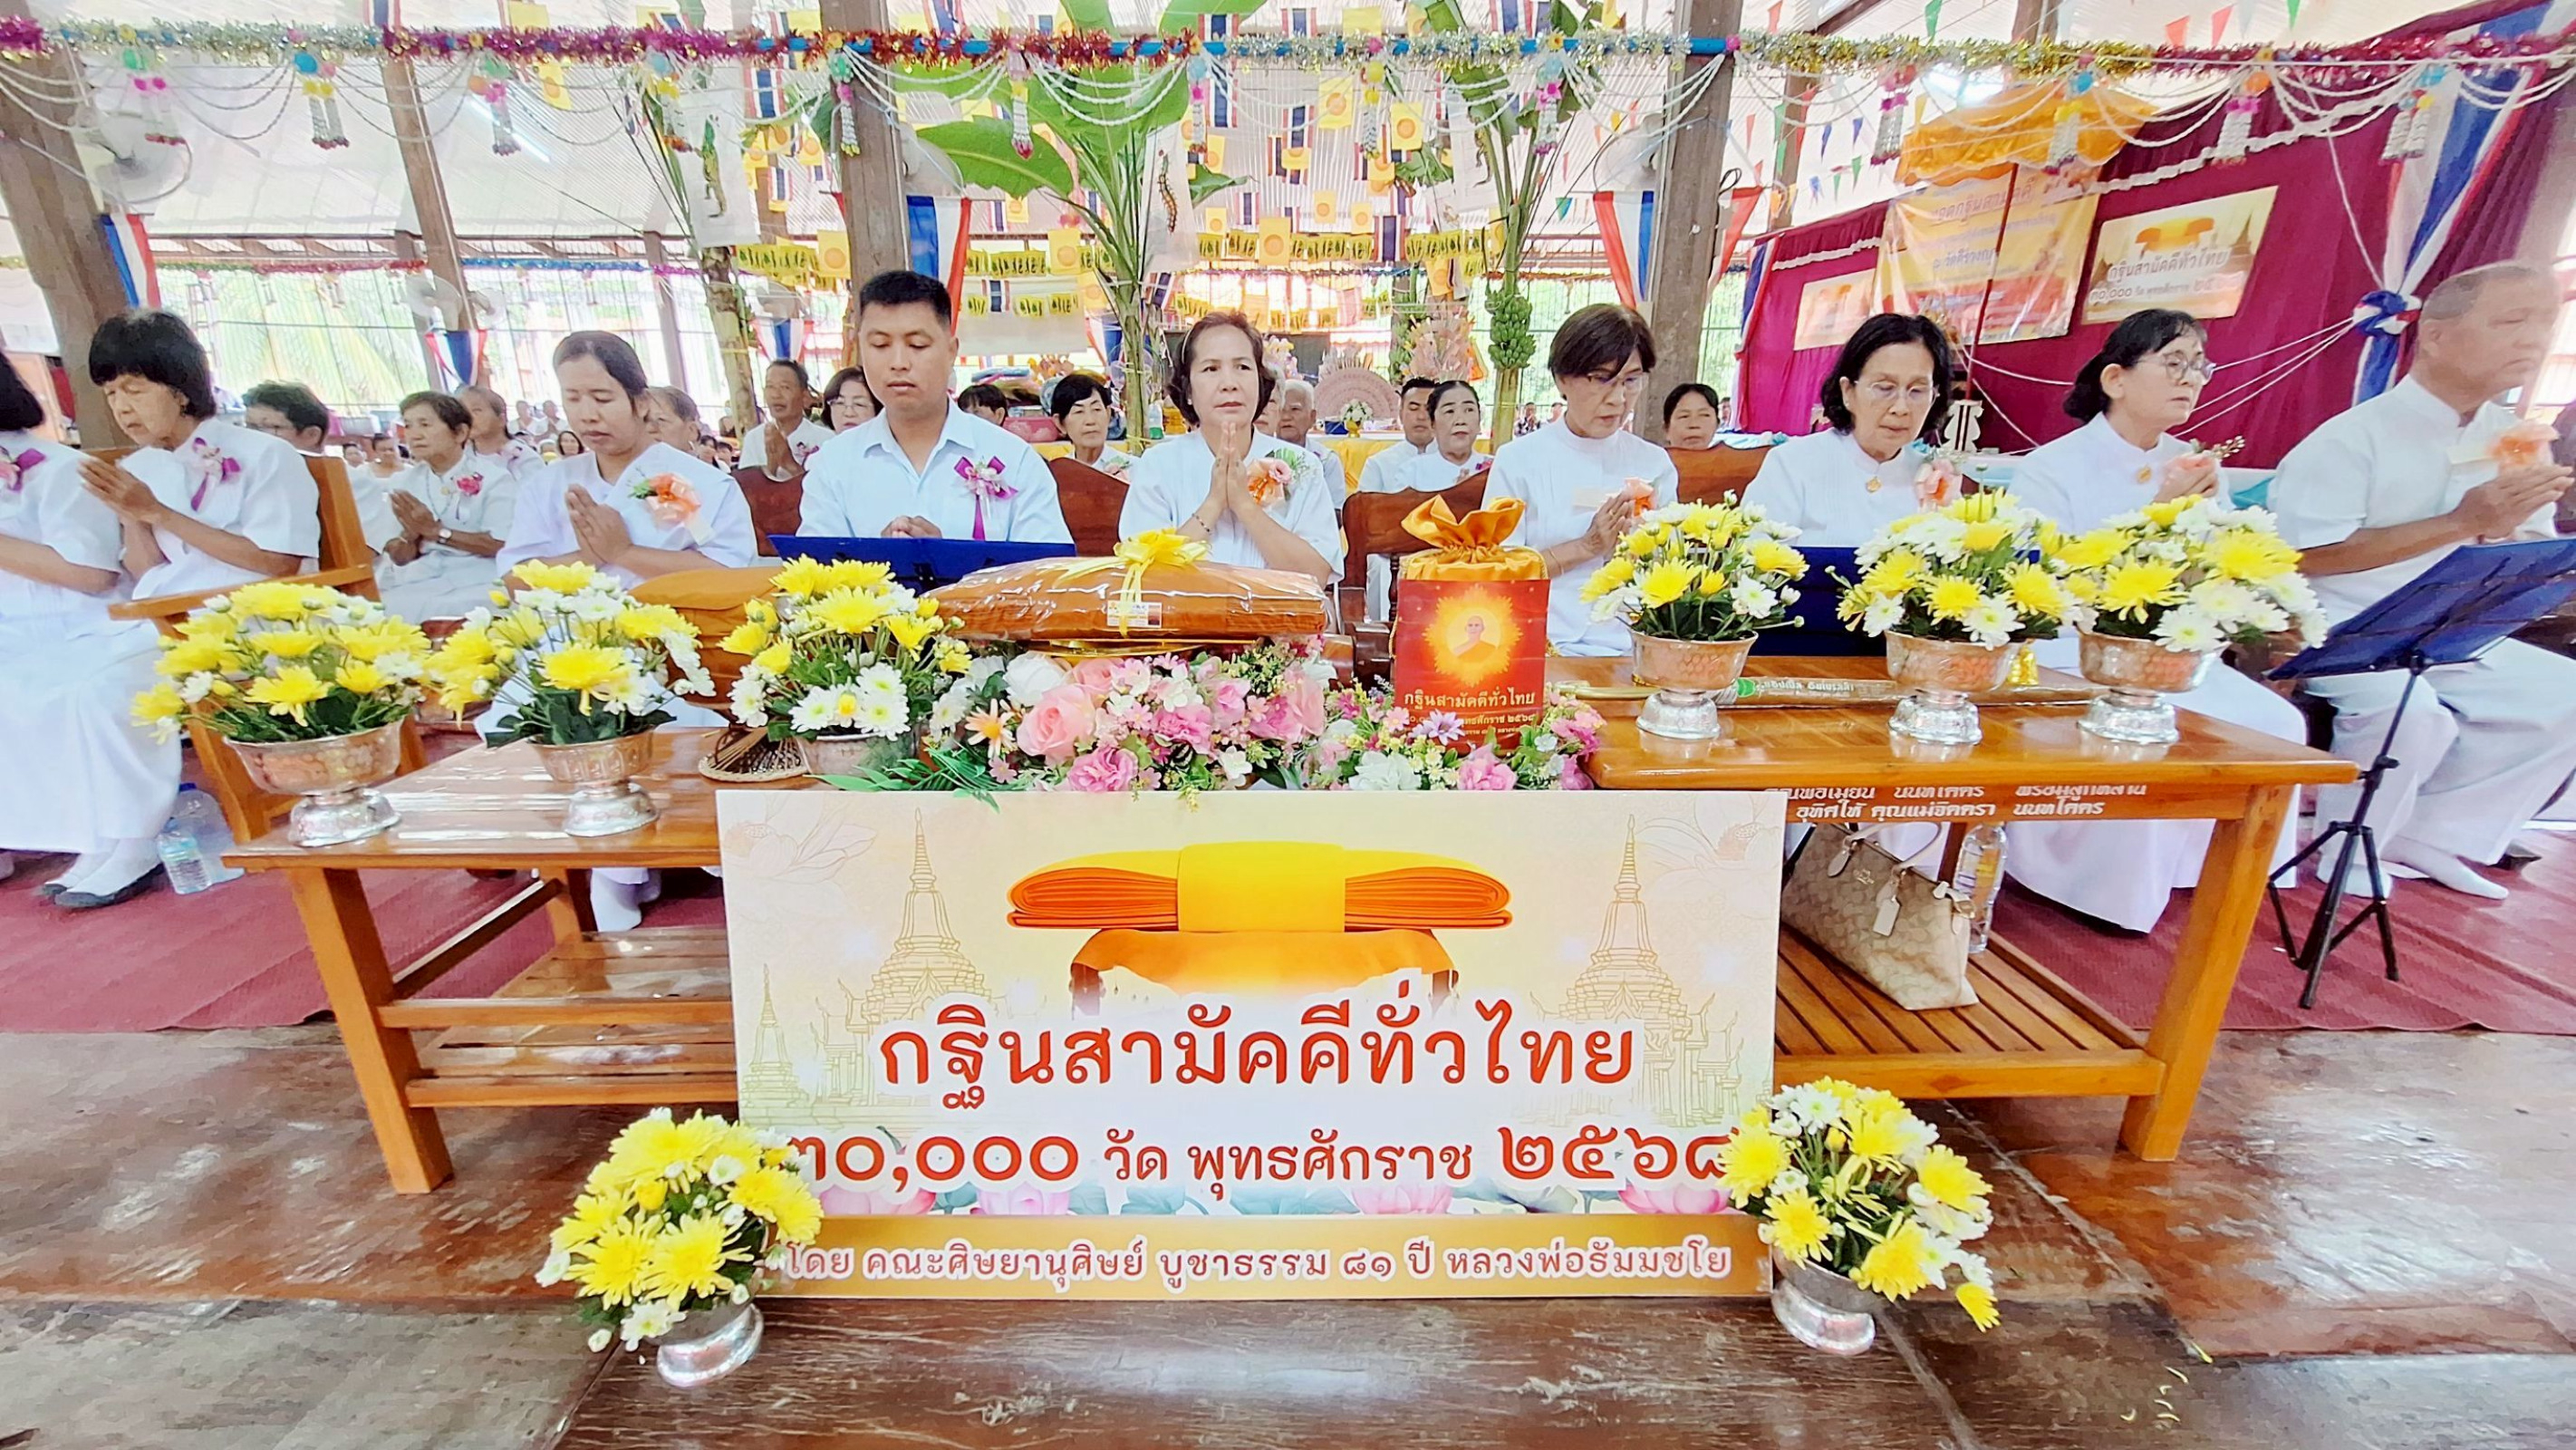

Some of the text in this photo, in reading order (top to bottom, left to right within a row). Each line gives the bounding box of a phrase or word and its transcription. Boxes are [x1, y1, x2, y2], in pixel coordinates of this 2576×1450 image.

[1404, 687, 1536, 710] กฐินสามัคคีทั่วไทย
[1462, 714, 1505, 728] ุทธศักราช
[881, 980, 1633, 1109] กฐินสามัคคีทั่วไทย
[1104, 1128, 1168, 1181] วัด
[1189, 1128, 1472, 1201] พุทธศักราช
[786, 1240, 1727, 1289] โดย คณะศิษยานุศิษย์ บูชาธรรม ๘๑ ปี หลวงพ่อธัมมชโย
